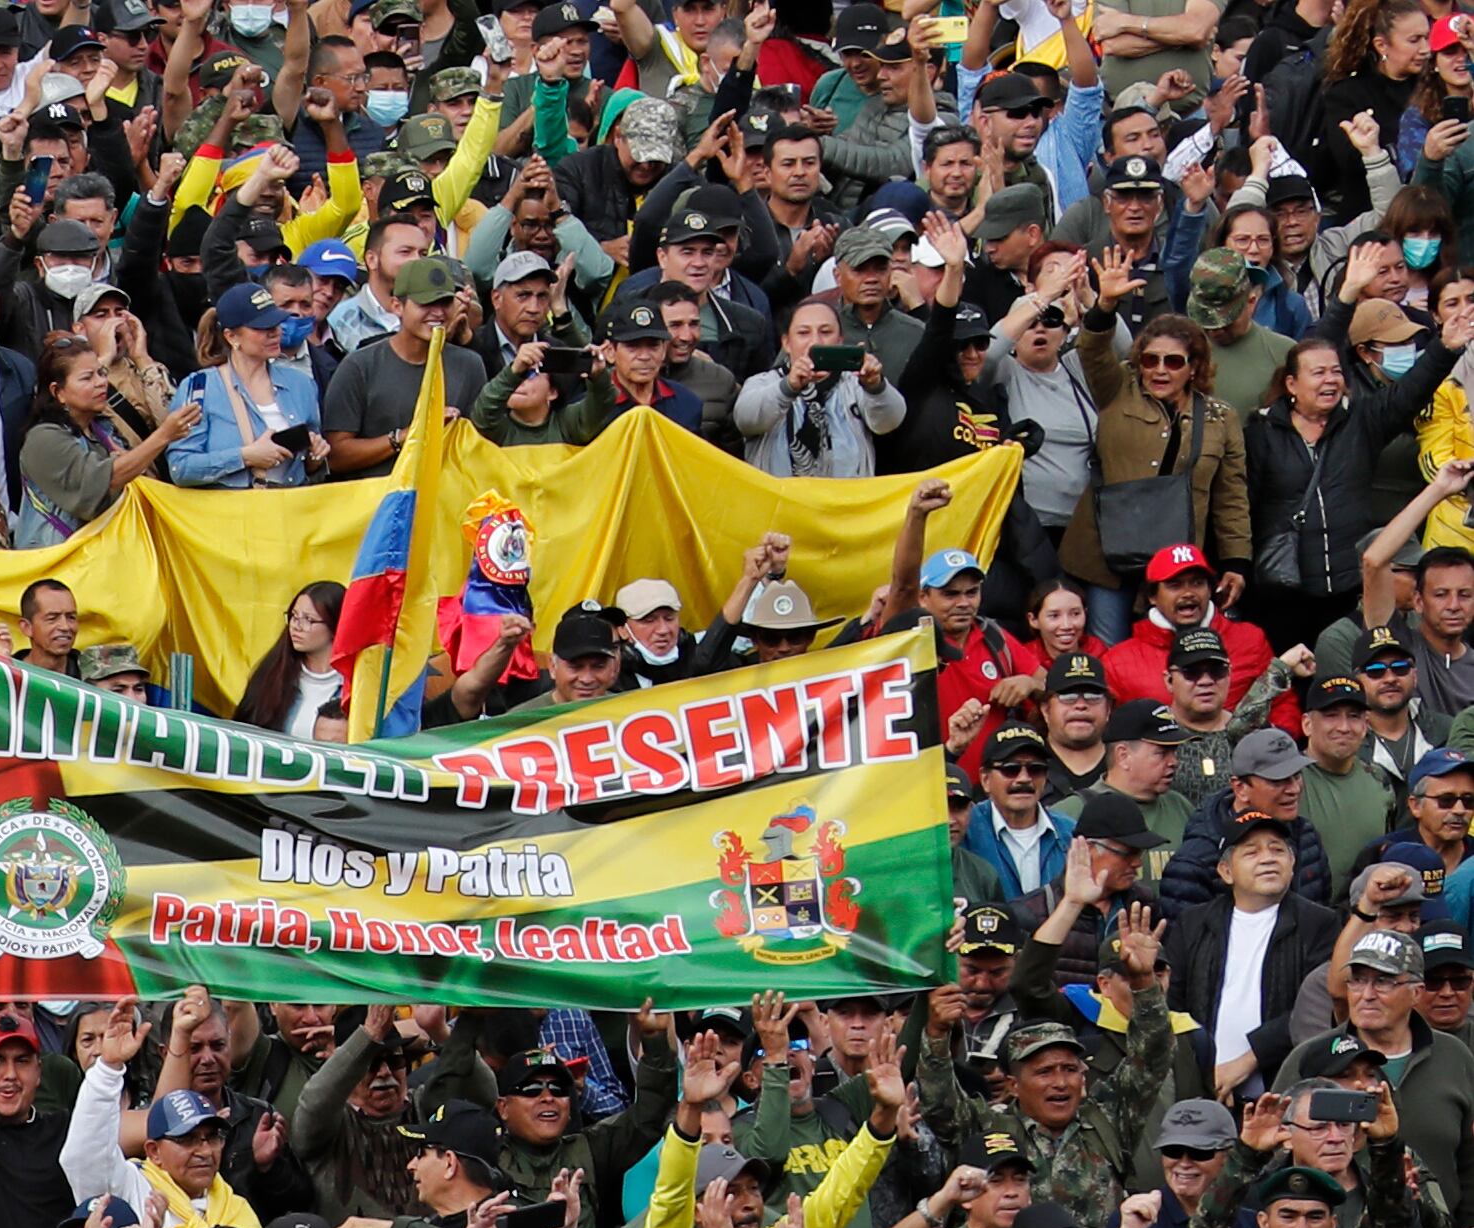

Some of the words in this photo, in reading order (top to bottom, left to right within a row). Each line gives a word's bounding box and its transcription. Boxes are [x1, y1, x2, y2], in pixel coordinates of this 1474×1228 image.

[1172, 546, 1194, 564] NY
[432, 656, 919, 815] PRESENTE
[33, 815, 52, 828] DE
[64, 824, 106, 893] COLOMBIA
[259, 827, 376, 889] Dios
[383, 850, 419, 897] y
[424, 844, 575, 899] Patria
[41, 904, 99, 939] NACIONAL
[147, 891, 324, 954] Patria,
[329, 906, 495, 963] Honor,
[494, 914, 692, 965] Lealtad
